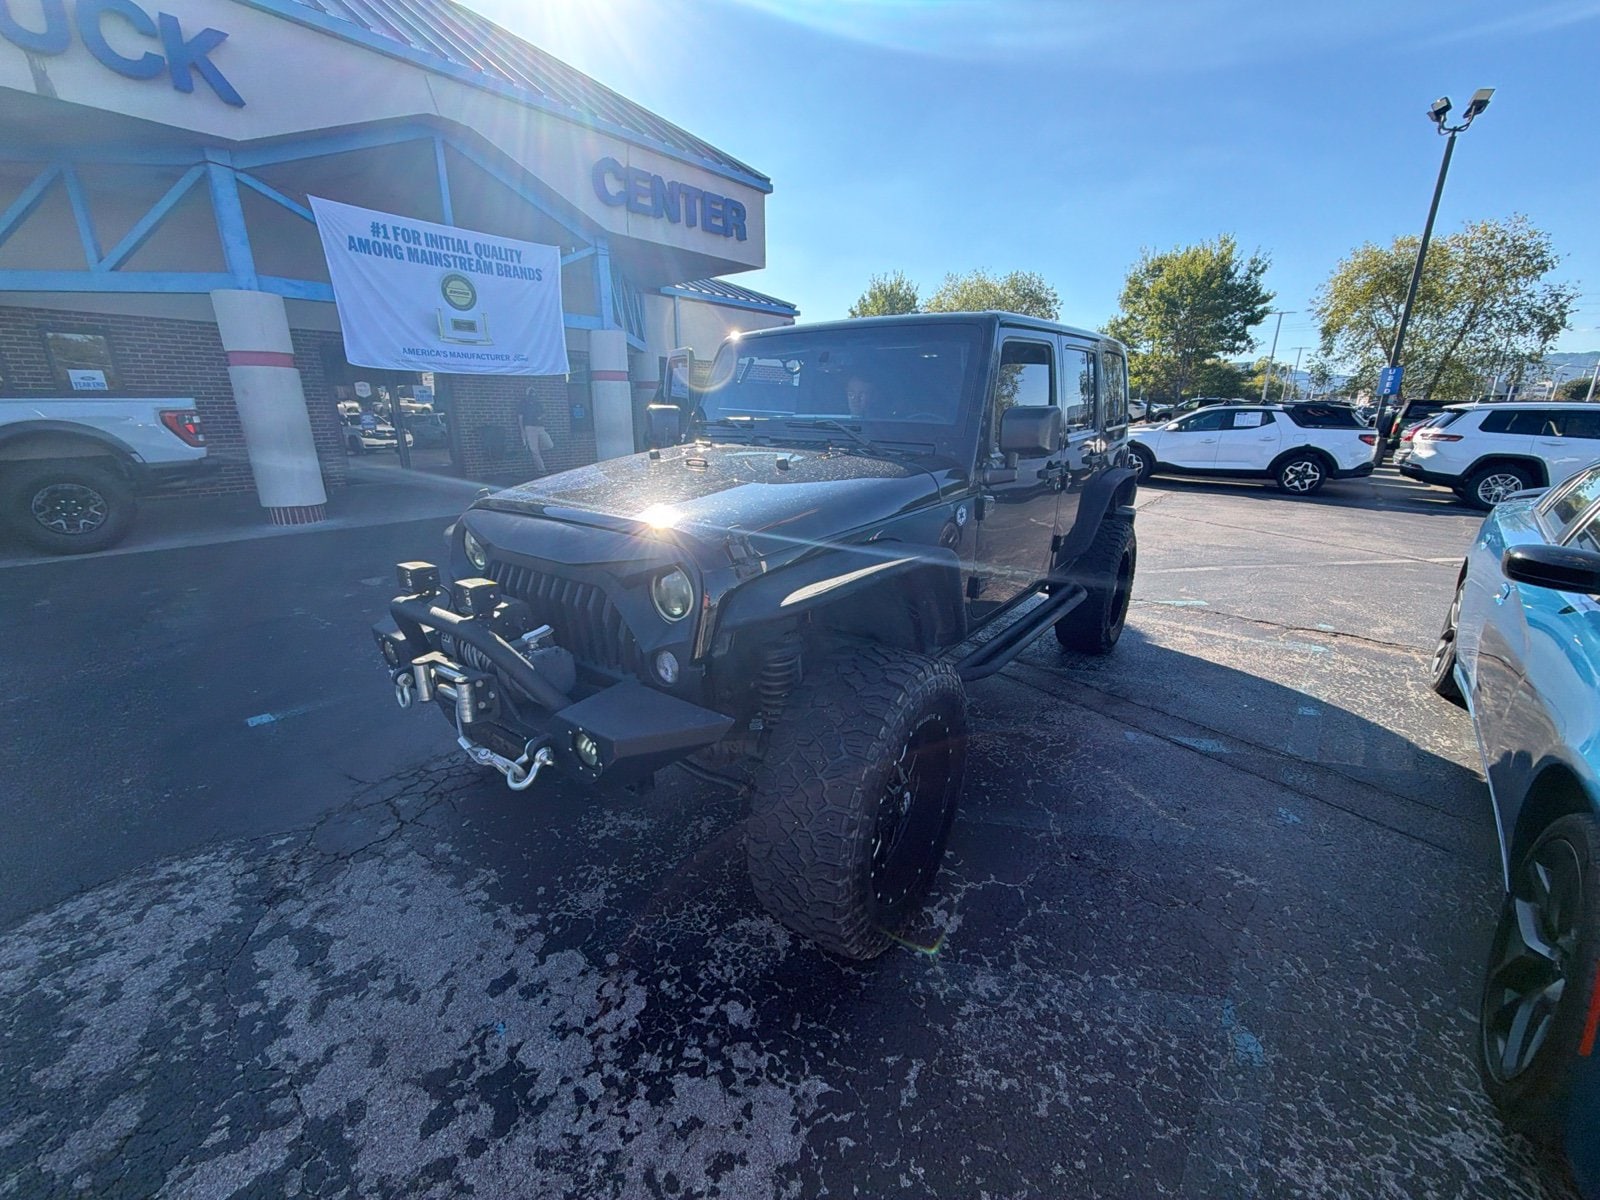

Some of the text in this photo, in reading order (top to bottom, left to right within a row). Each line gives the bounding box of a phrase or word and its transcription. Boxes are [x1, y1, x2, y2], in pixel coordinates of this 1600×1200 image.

[592, 156, 747, 241] CENTER
[347, 235, 543, 282] AMONG MAINSTREAM BRANDS
[370, 221, 522, 264] #1 FOR INITIAL QUALITY
[402, 347, 448, 359] AMERICA'S
[449, 351, 511, 361] MANUFACTURER
[1383, 368, 1397, 394] USED
